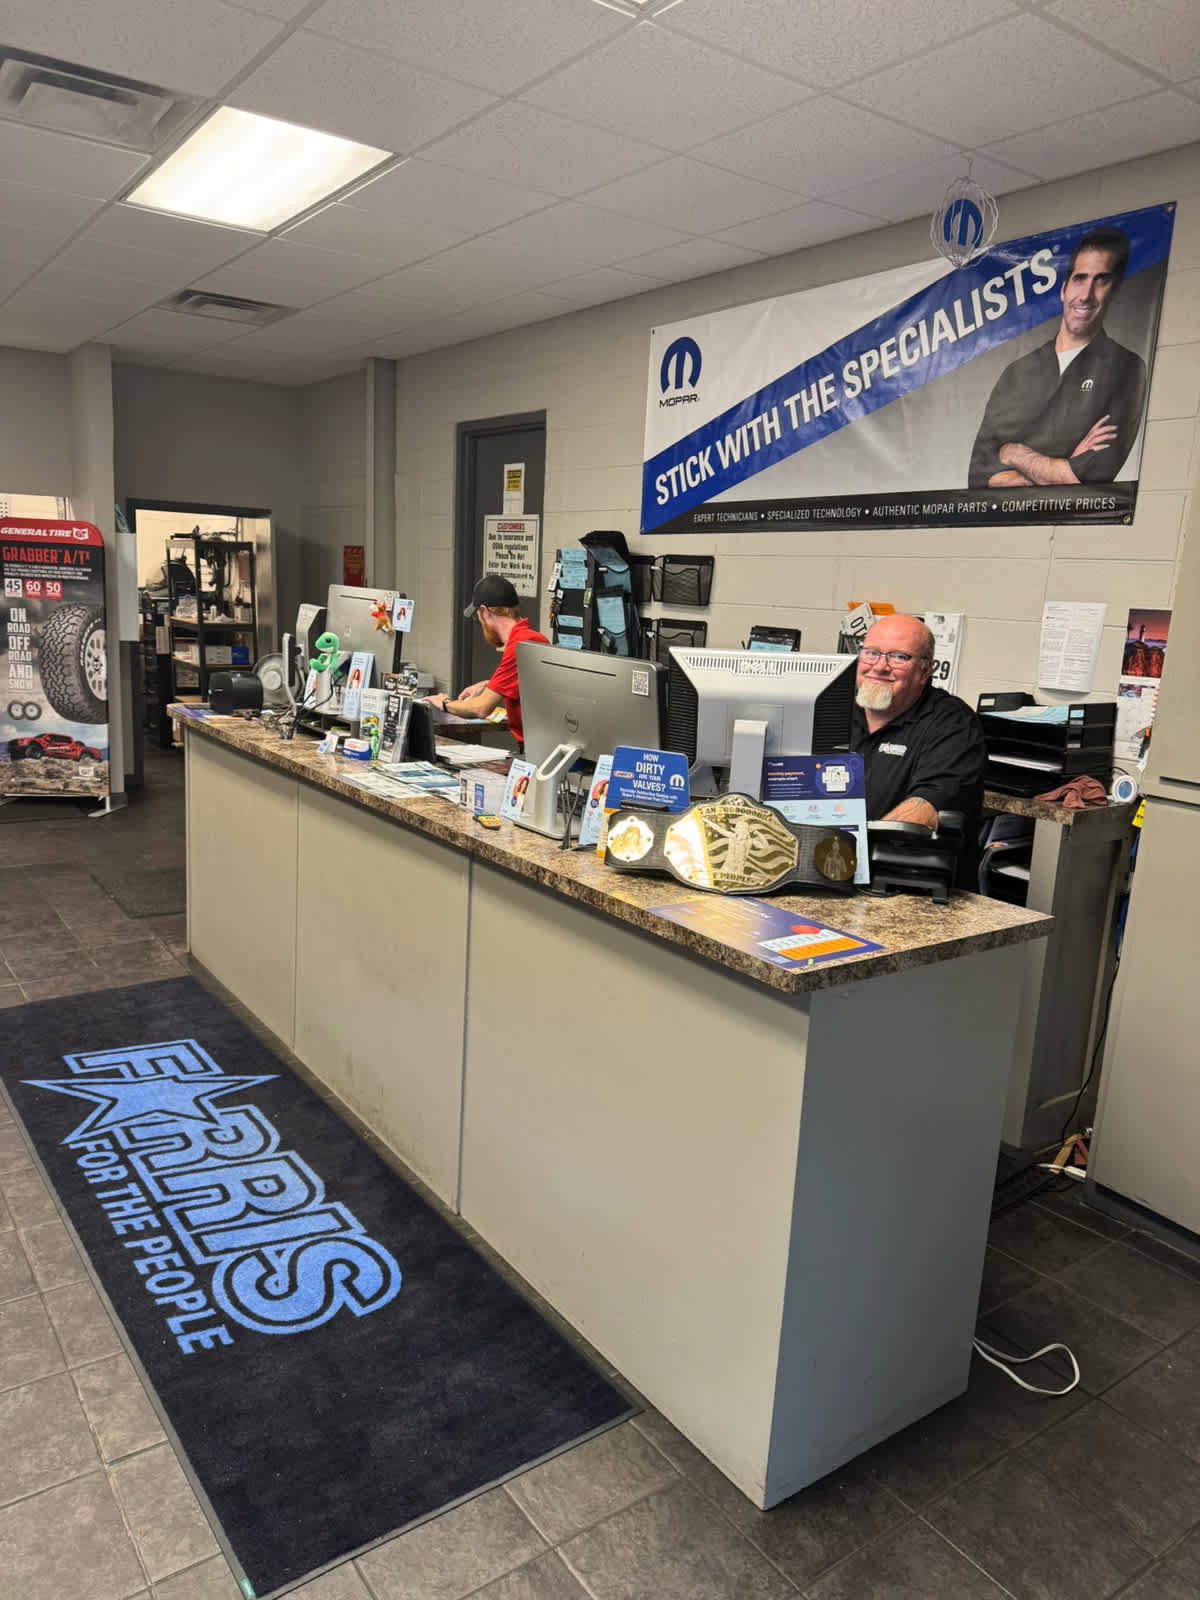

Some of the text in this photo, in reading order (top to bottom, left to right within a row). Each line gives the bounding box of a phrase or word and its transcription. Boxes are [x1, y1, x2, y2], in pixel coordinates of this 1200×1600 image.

[655, 248, 1058, 506] STICK WITH THE SPECIALISTS
[659, 394, 698, 409] MOPAR
[693, 497, 1116, 523] EXPERT TECHNICIANS SPECIALIZED TECHNOLOGY AUTHENTIC MOPAR PARTS COMPETITIVE PRICES
[0, 527, 72, 537] GENERAL TIRE
[1, 547, 58, 564] GRABBER
[25, 581, 41, 592] 60
[45, 582, 61, 593] 50
[10, 608, 27, 622] ON
[7, 622, 31, 633] ROAD
[9, 636, 31, 650] OFF
[8, 650, 32, 661] ROAD
[9, 663, 33, 679] AND
[8, 679, 33, 689] SNOW
[643, 752, 660, 762] HOW
[635, 761, 665, 776] DIRTY
[632, 780, 666, 793] VALVES?
[69, 1132, 236, 1356] FOR THE PEOPLE
